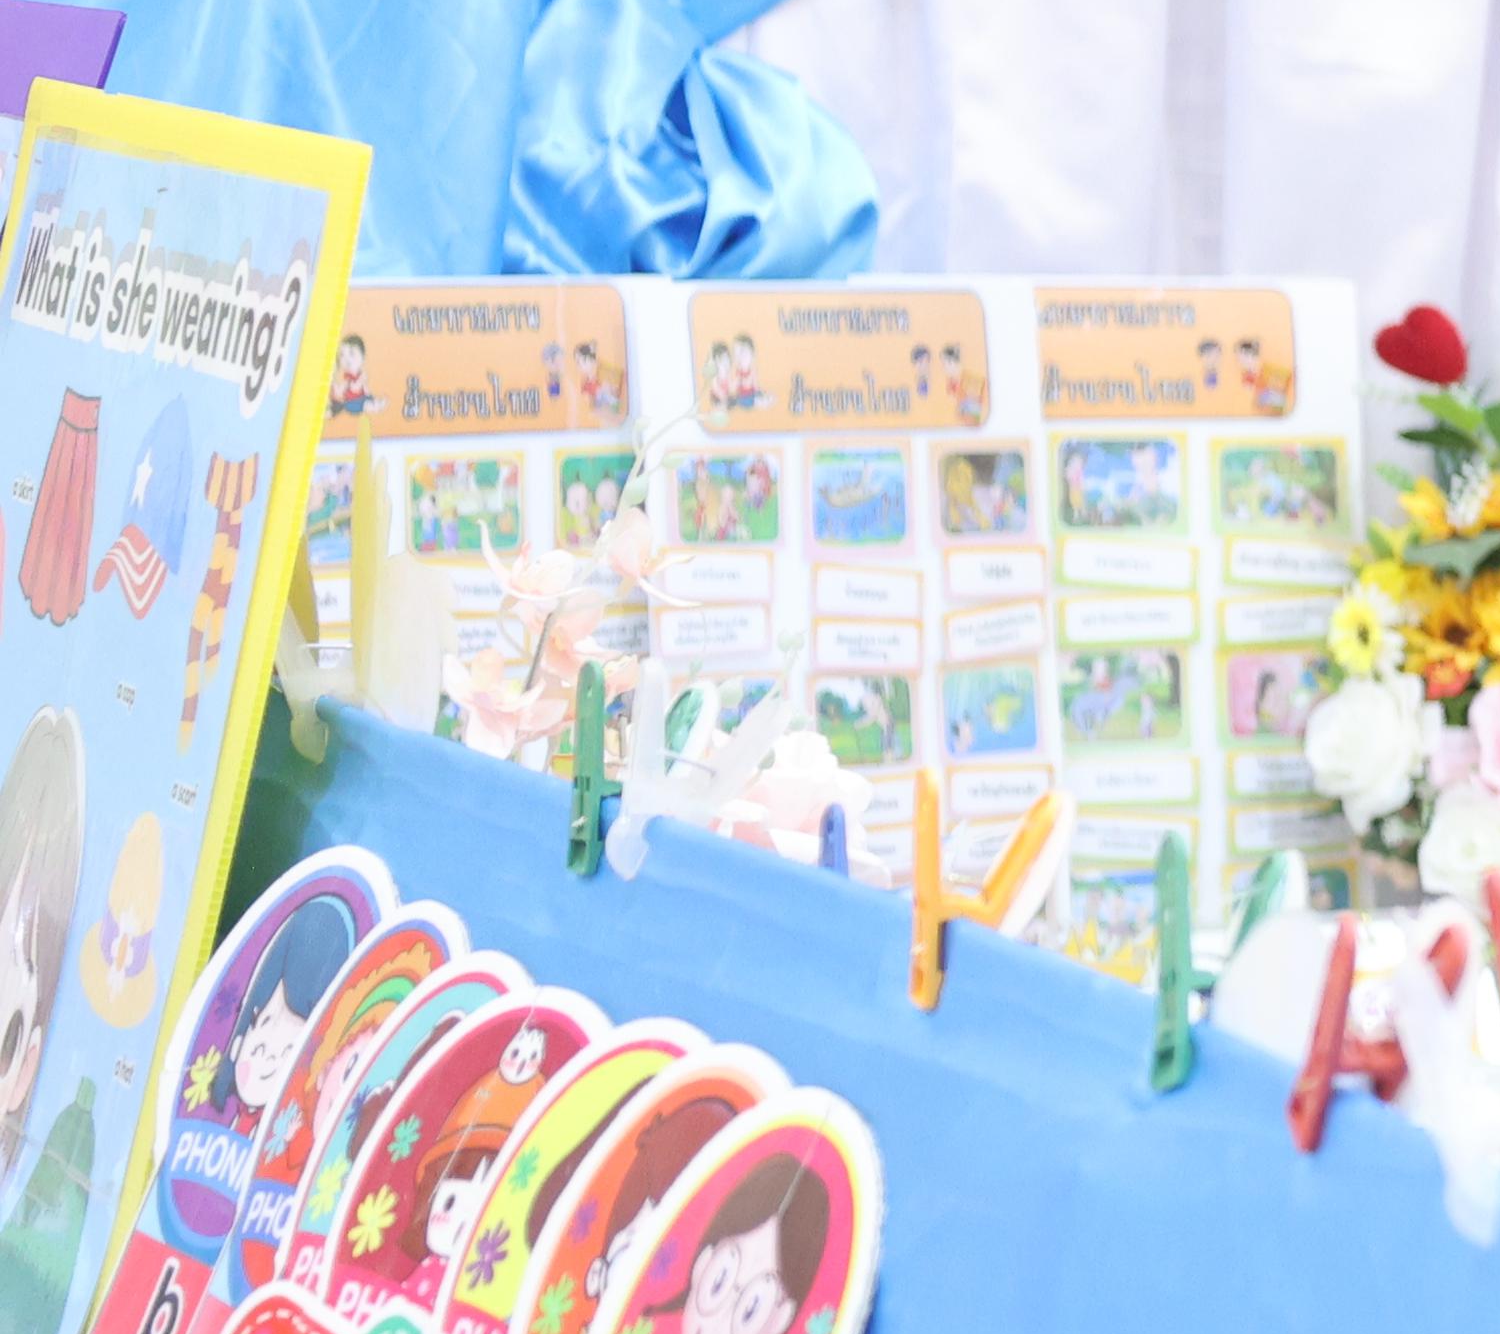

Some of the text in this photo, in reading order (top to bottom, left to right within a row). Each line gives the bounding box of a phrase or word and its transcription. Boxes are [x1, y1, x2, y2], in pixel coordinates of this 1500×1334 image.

[15, 221, 302, 403] What is she wearing?
[170, 1129, 254, 1194] PHONI
